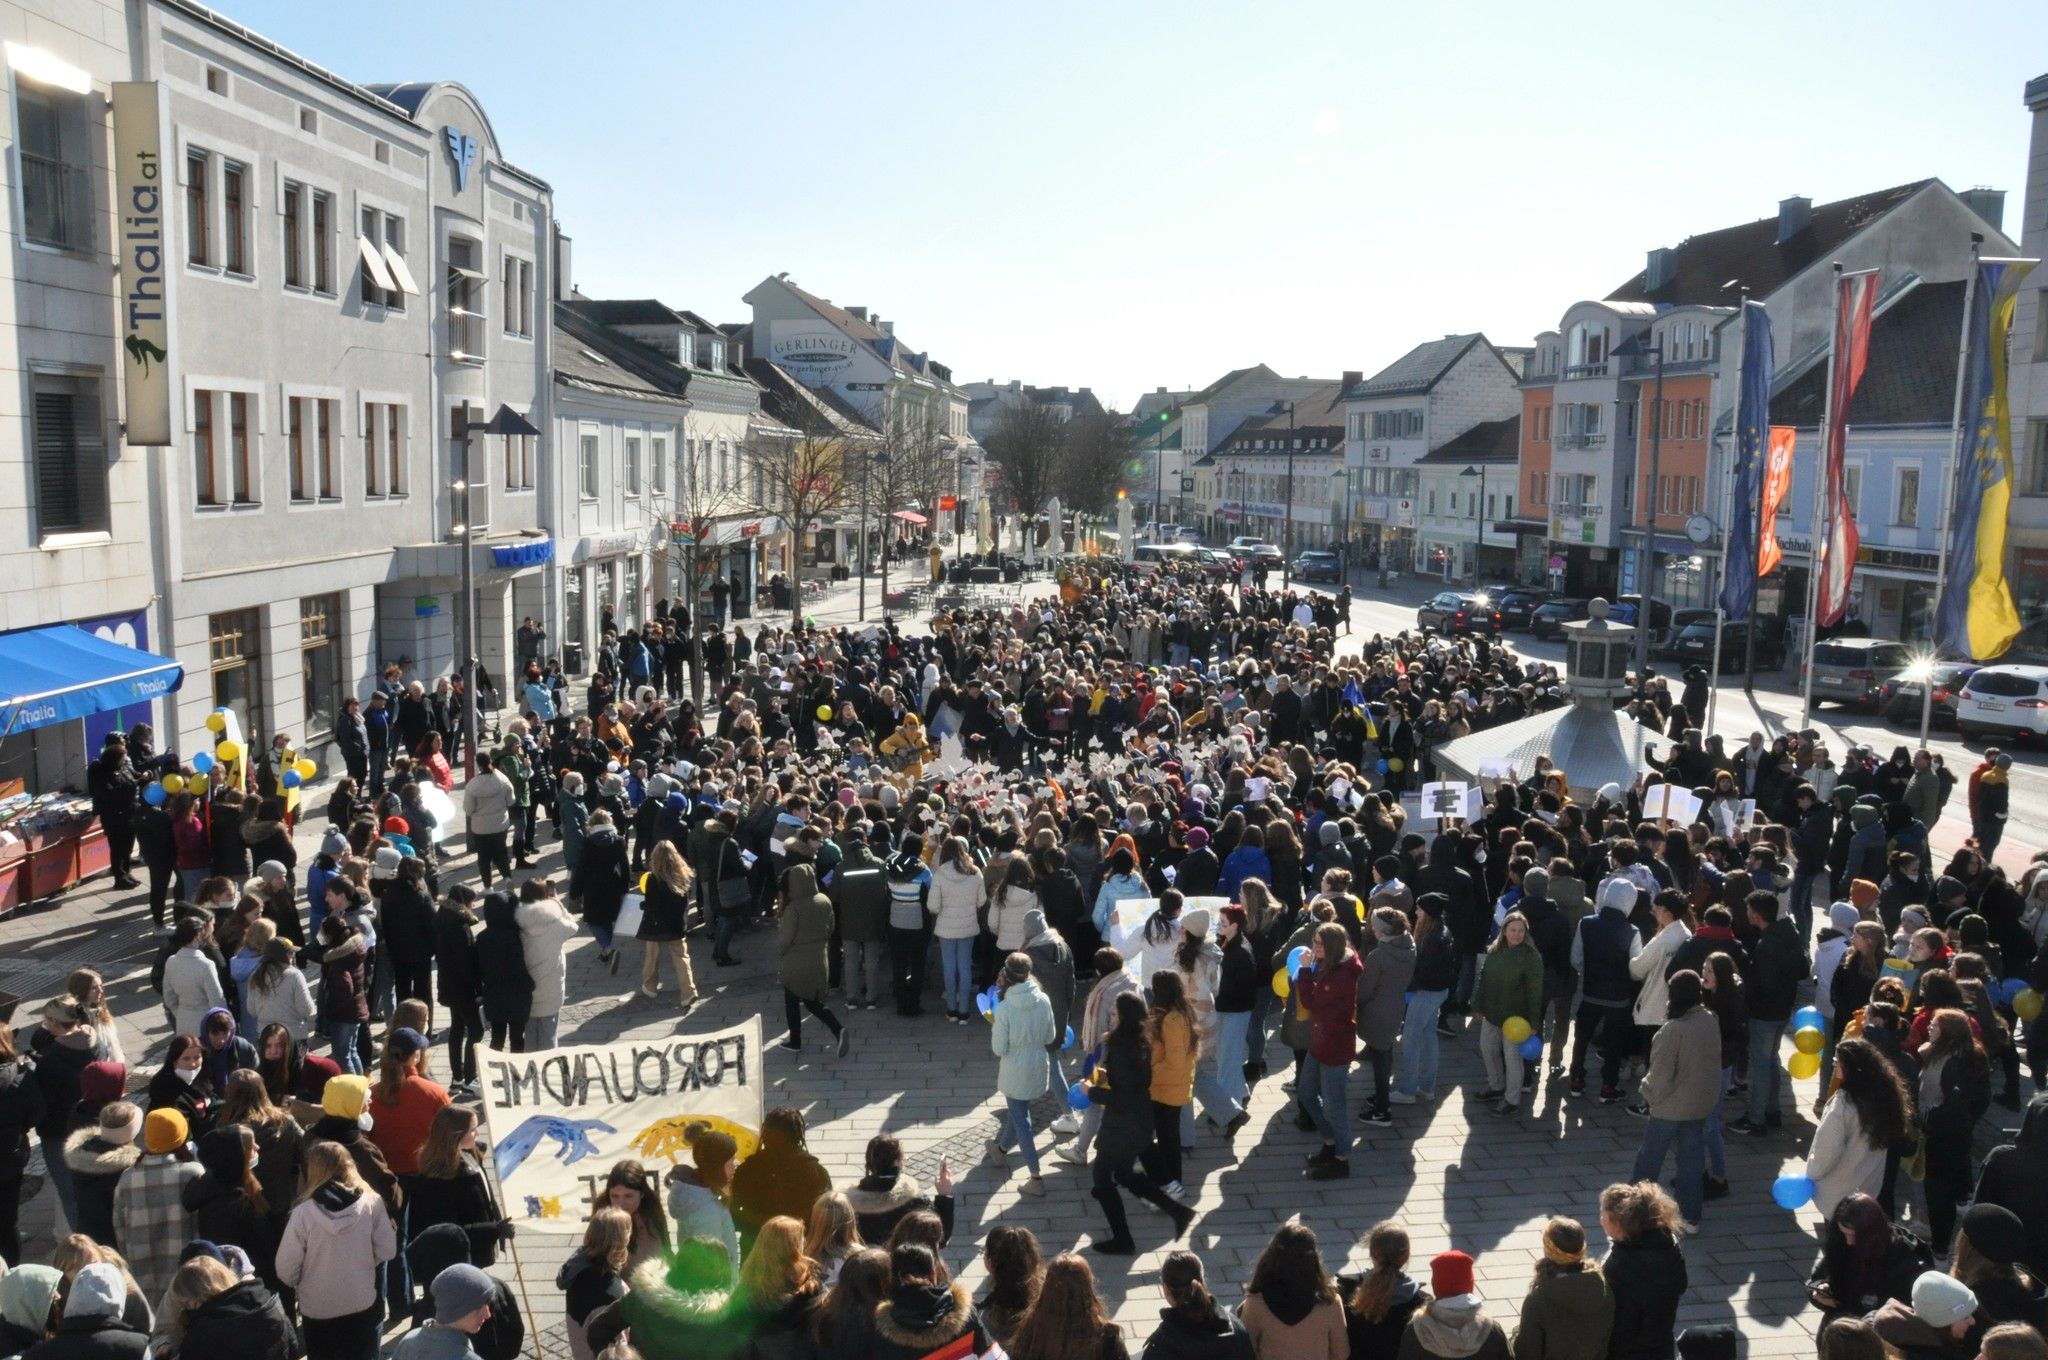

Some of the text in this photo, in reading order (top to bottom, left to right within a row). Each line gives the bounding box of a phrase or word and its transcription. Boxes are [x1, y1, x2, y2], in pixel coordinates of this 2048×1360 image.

[127, 151, 162, 330] Thalia.at
[774, 338, 858, 354] GERLINGER
[138, 679, 167, 695] Thalia
[19, 706, 56, 725] Thalia
